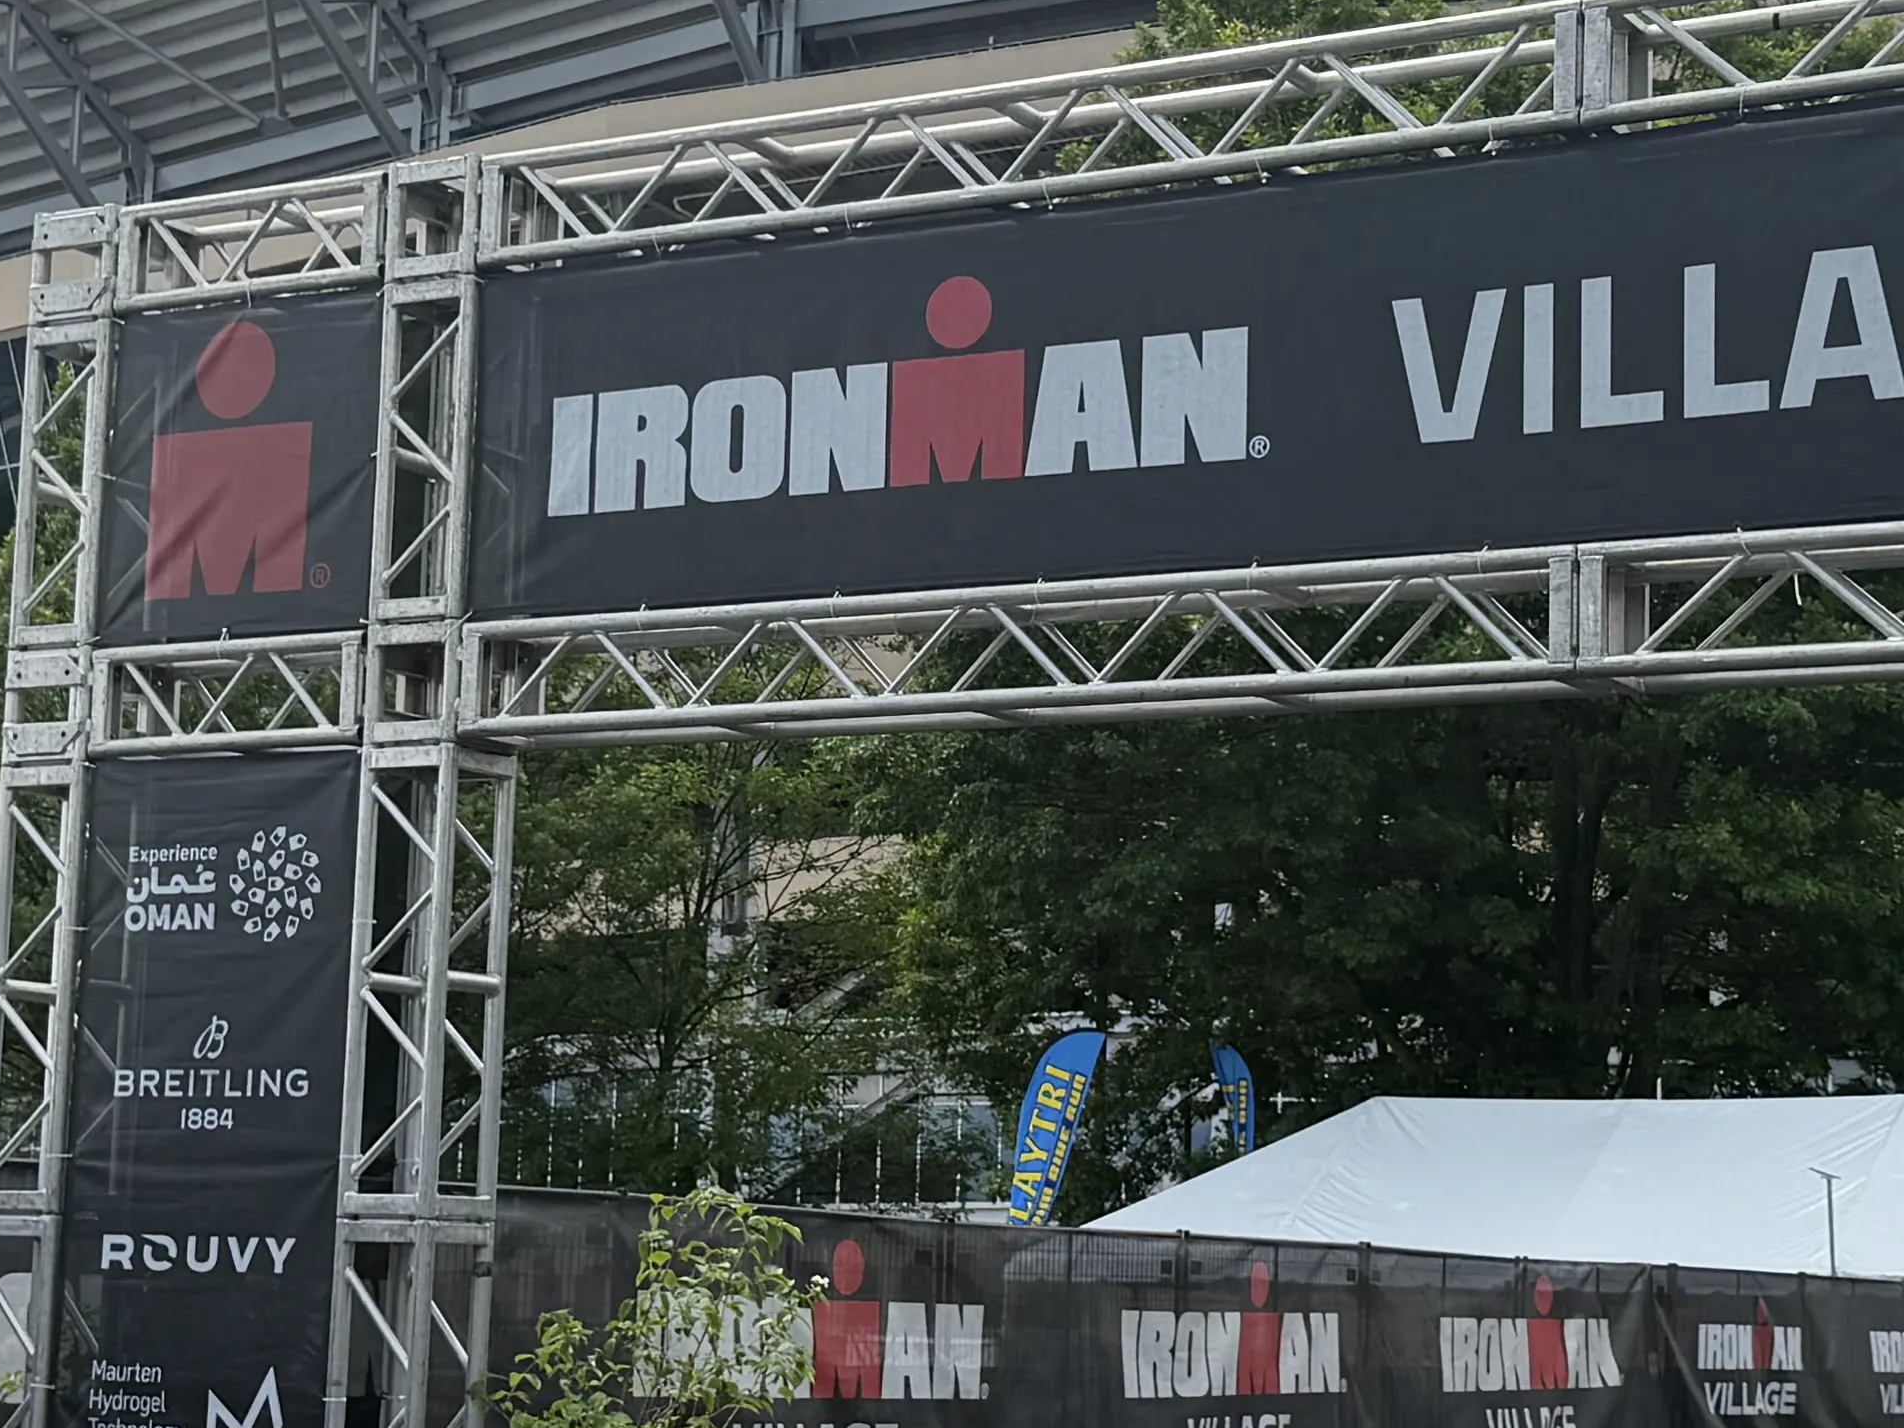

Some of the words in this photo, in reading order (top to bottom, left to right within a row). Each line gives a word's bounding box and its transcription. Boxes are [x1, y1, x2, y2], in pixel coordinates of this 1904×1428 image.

[547, 276, 1250, 518] IRONMAN
[128, 843, 218, 867] Experience
[124, 902, 215, 932] OMAN
[113, 1069, 310, 1098] BREITLING
[180, 1108, 234, 1130] 1884
[1009, 1064, 1072, 1223] LAYTRI
[100, 1233, 296, 1274] ROUVY
[1121, 1261, 1340, 1399] IRONMAN
[90, 1360, 162, 1383] Maurten
[88, 1388, 167, 1415] Hydrogel
[1704, 1381, 1797, 1416] VILLAGE
